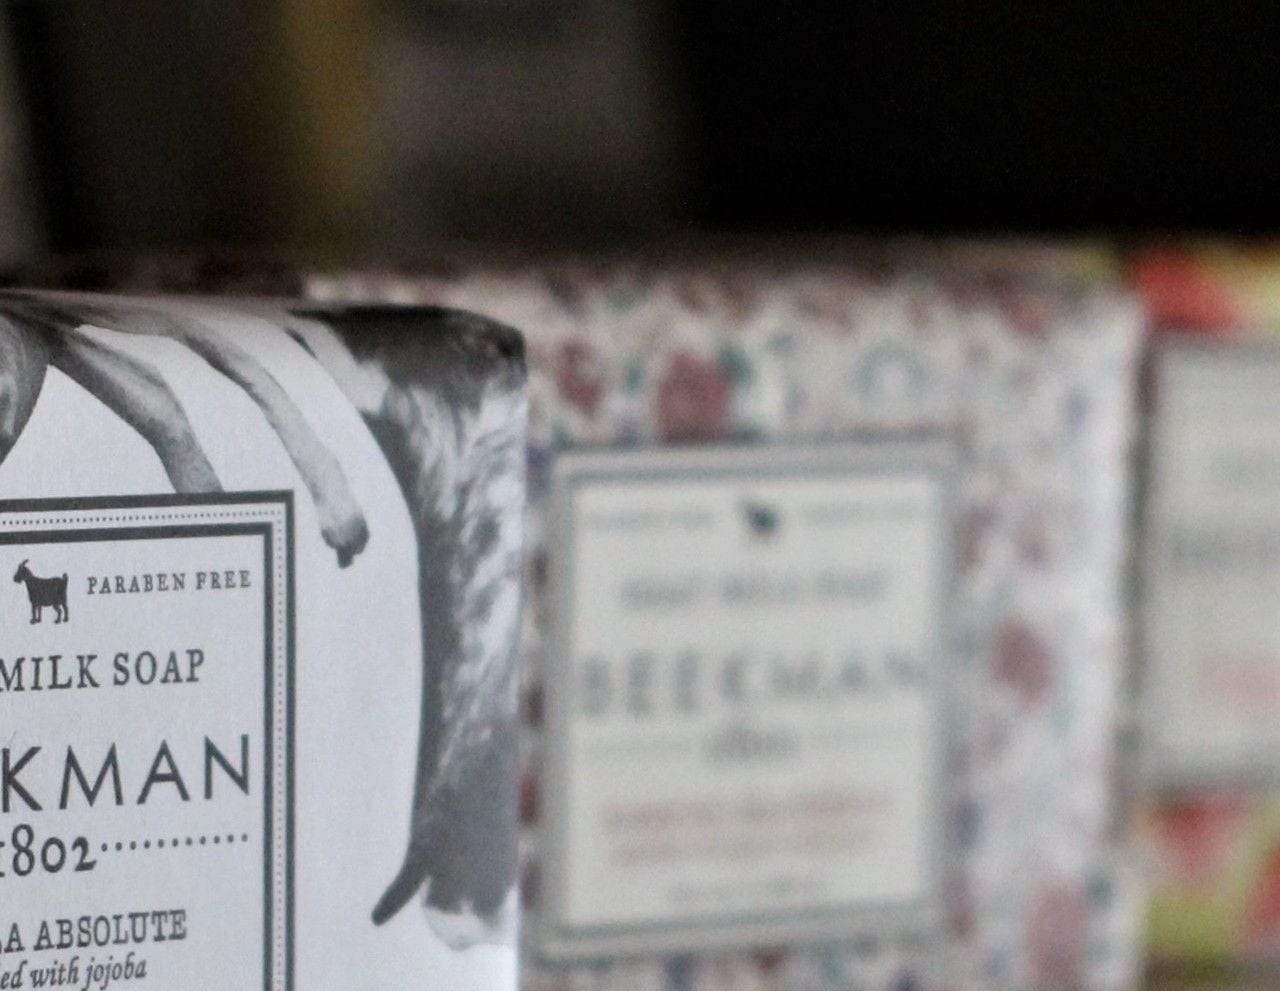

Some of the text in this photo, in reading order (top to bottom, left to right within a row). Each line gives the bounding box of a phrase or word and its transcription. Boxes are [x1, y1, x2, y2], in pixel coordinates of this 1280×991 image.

[87, 570, 251, 595] PARABEN FREE
[113, 649, 205, 686] SOAP
[34, 909, 187, 950] ABSOLUTE
[30, 956, 79, 987] with
[84, 952, 147, 991] jojoba
